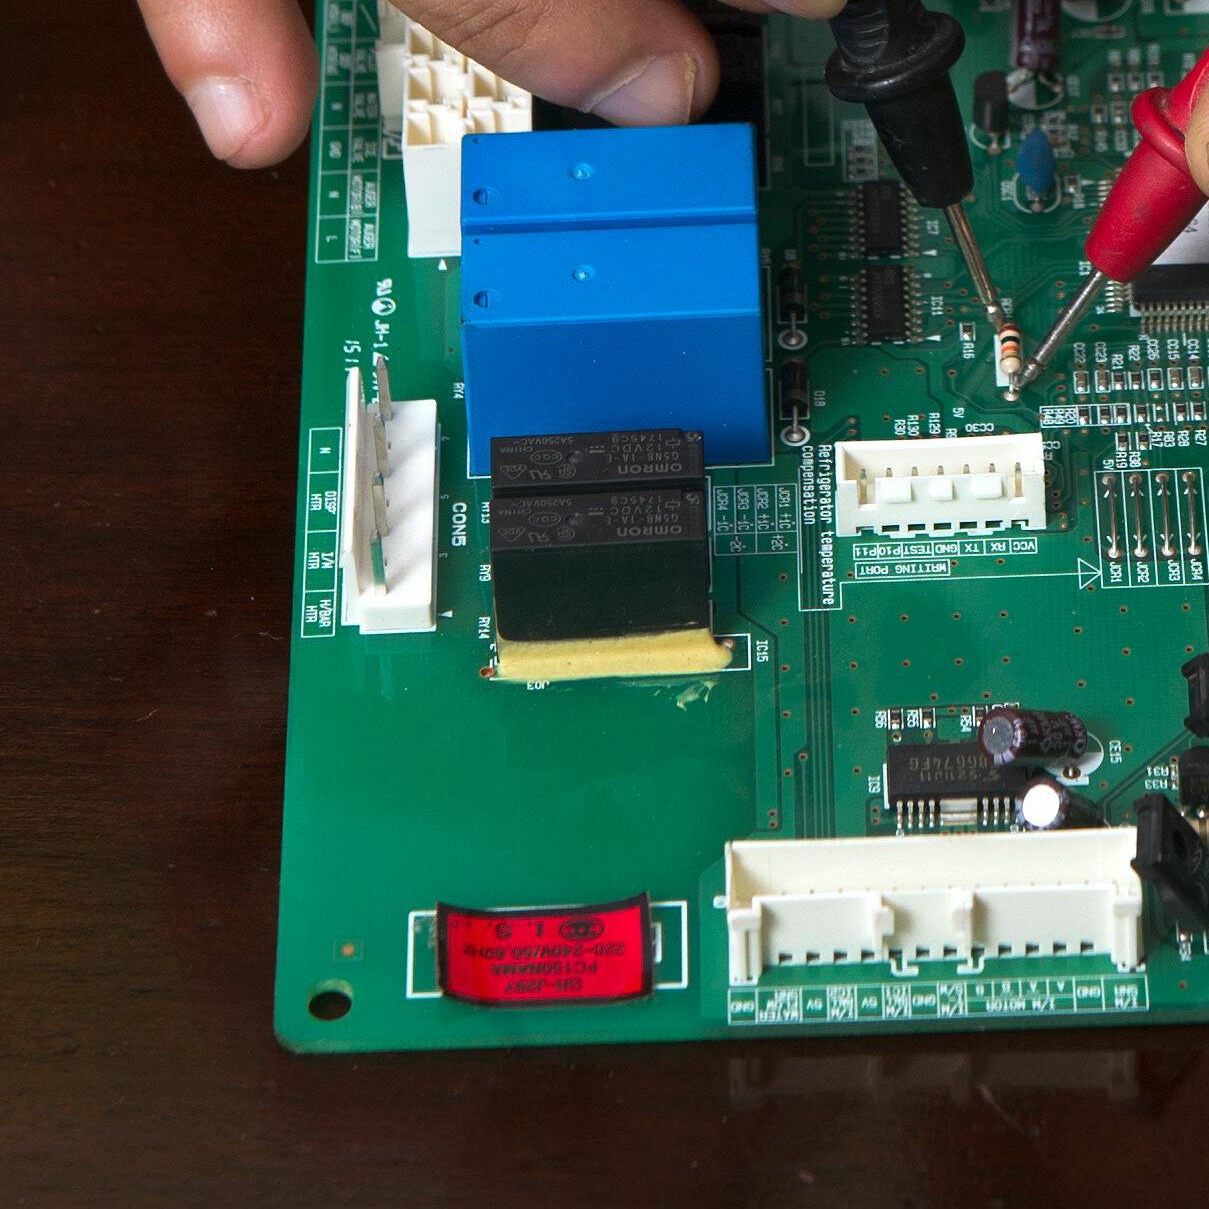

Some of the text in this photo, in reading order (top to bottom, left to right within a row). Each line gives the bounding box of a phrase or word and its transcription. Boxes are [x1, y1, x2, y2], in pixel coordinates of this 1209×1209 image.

[931, 296, 943, 315] IC11
[1129, 345, 1140, 361] R22
[1188, 339, 1199, 360] CC14
[1112, 354, 1123, 369] R21
[1064, 408, 1075, 424] R20
[895, 419, 905, 435] R30
[1151, 432, 1162, 447] R17
[1195, 430, 1206, 446] R27
[1103, 459, 1114, 470] 5V
[1115, 452, 1127, 468] R19
[801, 445, 816, 526] compensation
[310, 493, 322, 510] HTR
[716, 489, 729, 510] JCR4
[737, 488, 750, 509] JCR3
[757, 487, 769, 509] JCR2
[778, 486, 790, 507] JCR1
[451, 502, 467, 547] CON5
[818, 443, 835, 606] Refrigerator temperature
[855, 545, 877, 559] P11
[879, 544, 901, 557] P10
[904, 543, 932, 557] TEST
[936, 543, 959, 555] GND
[965, 542, 981, 554] TX
[990, 541, 1006, 552] RX
[1013, 539, 1036, 551] VCC
[307, 552, 320, 569] HTR
[478, 564, 491, 581] RY9
[858, 562, 947, 577] WRITING PORT
[1110, 562, 1121, 582] JCR1
[1136, 561, 1149, 583] JCR2
[1168, 560, 1180, 581] JCR3
[1191, 559, 1203, 580] JCR4
[305, 605, 317, 622] HTR
[318, 599, 334, 627] H/BAR
[478, 616, 491, 639] RY14
[756, 639, 769, 663] IC15
[1147, 766, 1169, 776] R31
[1145, 779, 1168, 790] R33
